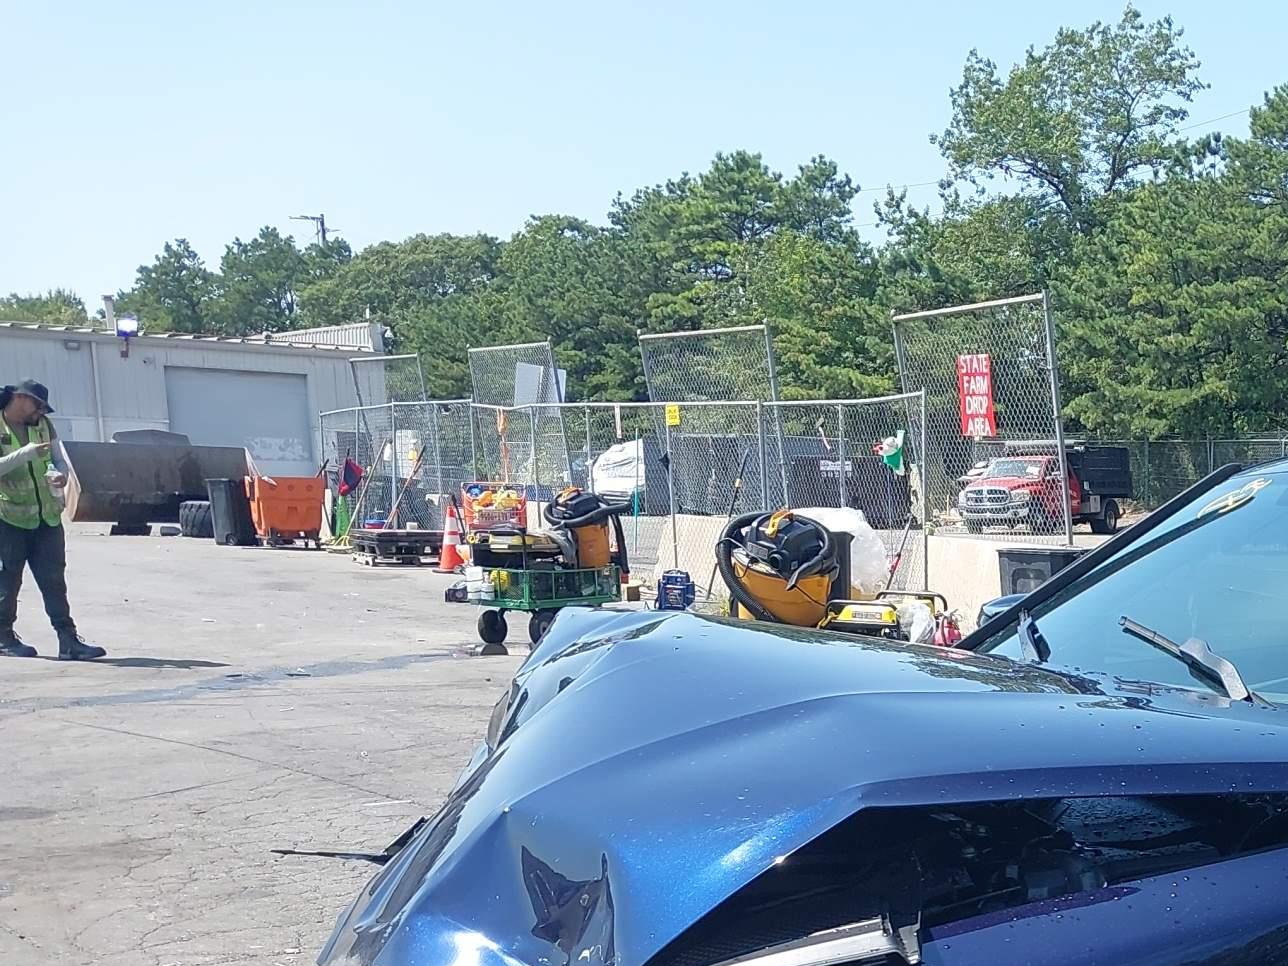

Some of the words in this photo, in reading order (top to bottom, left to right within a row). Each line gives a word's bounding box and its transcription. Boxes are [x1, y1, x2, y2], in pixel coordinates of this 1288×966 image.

[960, 354, 988, 373] STATE
[963, 375, 988, 395] FARM
[965, 396, 988, 415] DROP
[967, 418, 992, 436] AREA
